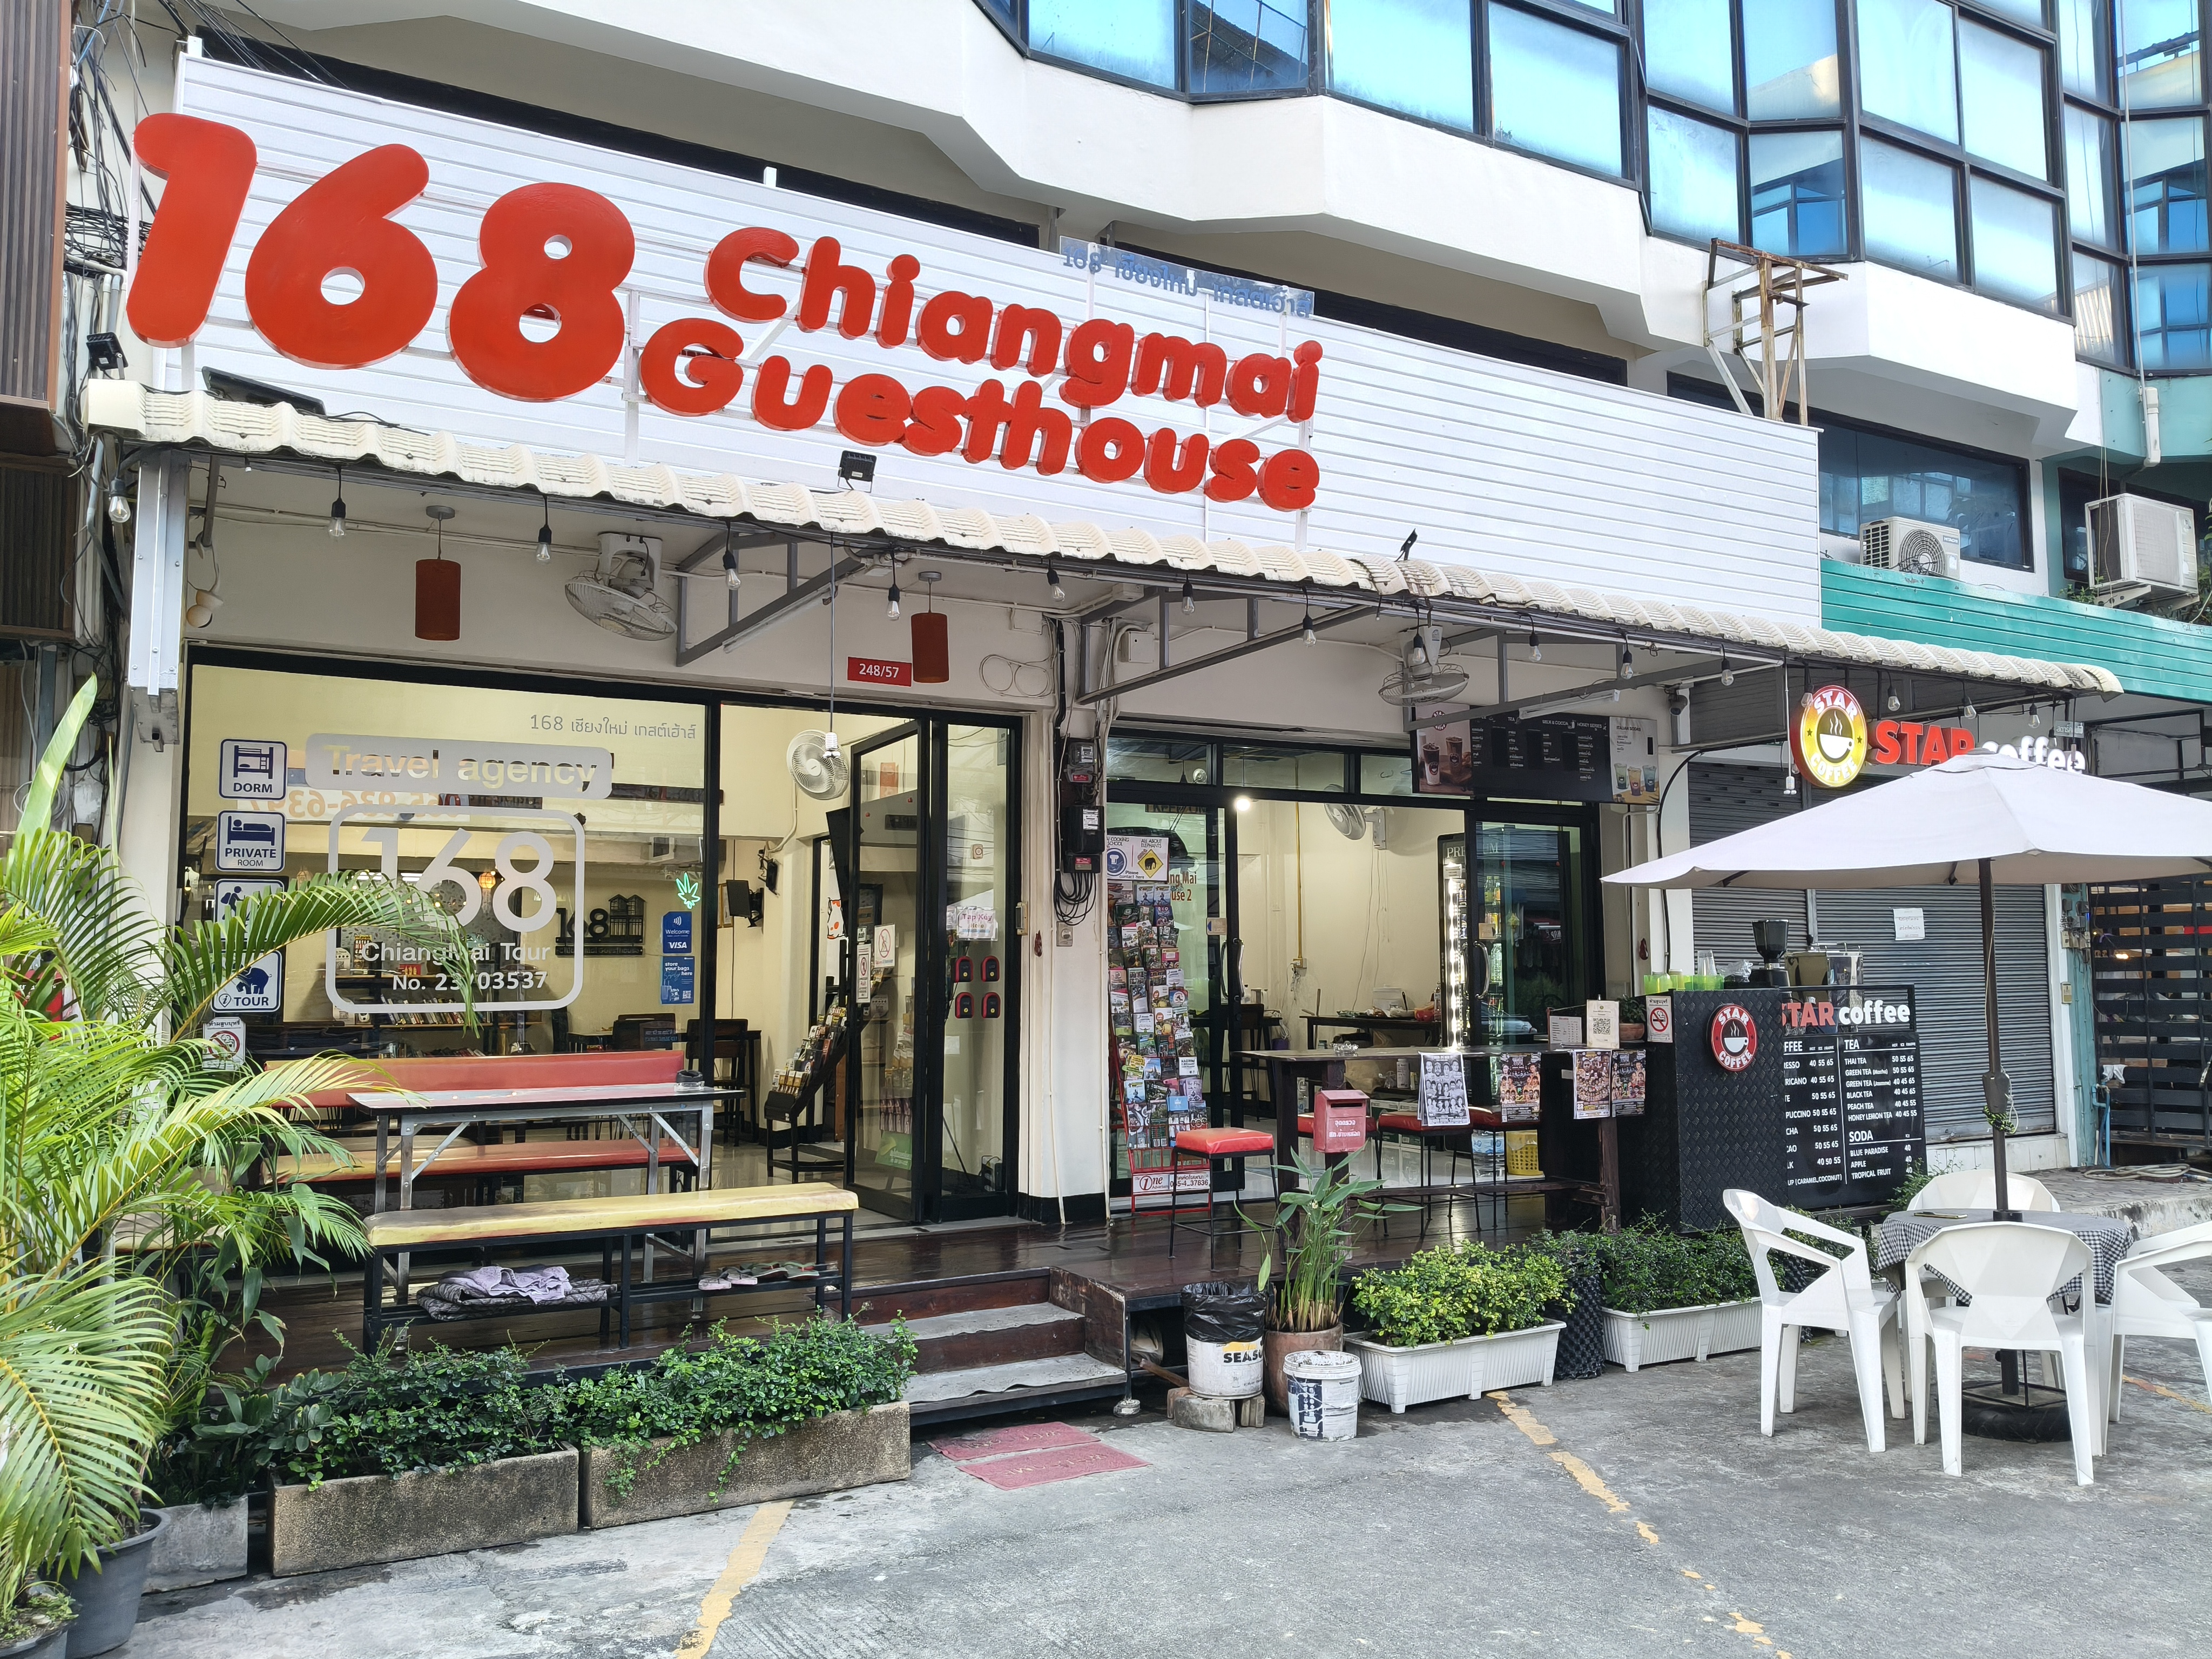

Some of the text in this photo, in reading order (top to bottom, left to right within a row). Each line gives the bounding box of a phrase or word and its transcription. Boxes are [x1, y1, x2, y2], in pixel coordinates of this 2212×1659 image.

[126, 112, 636, 403] 168
[1063, 245, 1102, 274] 168
[704, 226, 1324, 423] Chiangmai
[639, 317, 1321, 512] Guesthouse
[859, 663, 899, 678] 248/57
[1814, 691, 1858, 721] STAR
[530, 714, 563, 731] 168
[571, 717, 628, 735] เชียงใหม่
[325, 745, 598, 793] Travel agency
[1811, 753, 1858, 781] COFFEE
[233, 783, 273, 793] DORM
[225, 847, 276, 858] PRIVATE
[361, 827, 557, 933] 168
[1182, 872, 1197, 885] Mai
[1187, 889, 1192, 901] 2
[962, 913, 992, 922] Tap Key
[500, 942, 551, 961] Tour
[393, 974, 426, 990] No.
[233, 996, 269, 1007] TOUR
[1718, 1008, 1749, 1026] STAR
[1838, 1000, 1911, 1025] coffee
[1784, 1041, 1803, 1052] FFEE
[1844, 1039, 1859, 1050] TEA
[1718, 1050, 1754, 1069] COFFEE
[1785, 1077, 1807, 1086] RICANO
[1785, 1110, 1811, 1119] PUCCINO
[1786, 1127, 1798, 1135] CHA
[1849, 1130, 1873, 1142] SODA
[1864, 1147, 1889, 1155] PARADISE
[1851, 1170, 1876, 1179] TROPICAL
